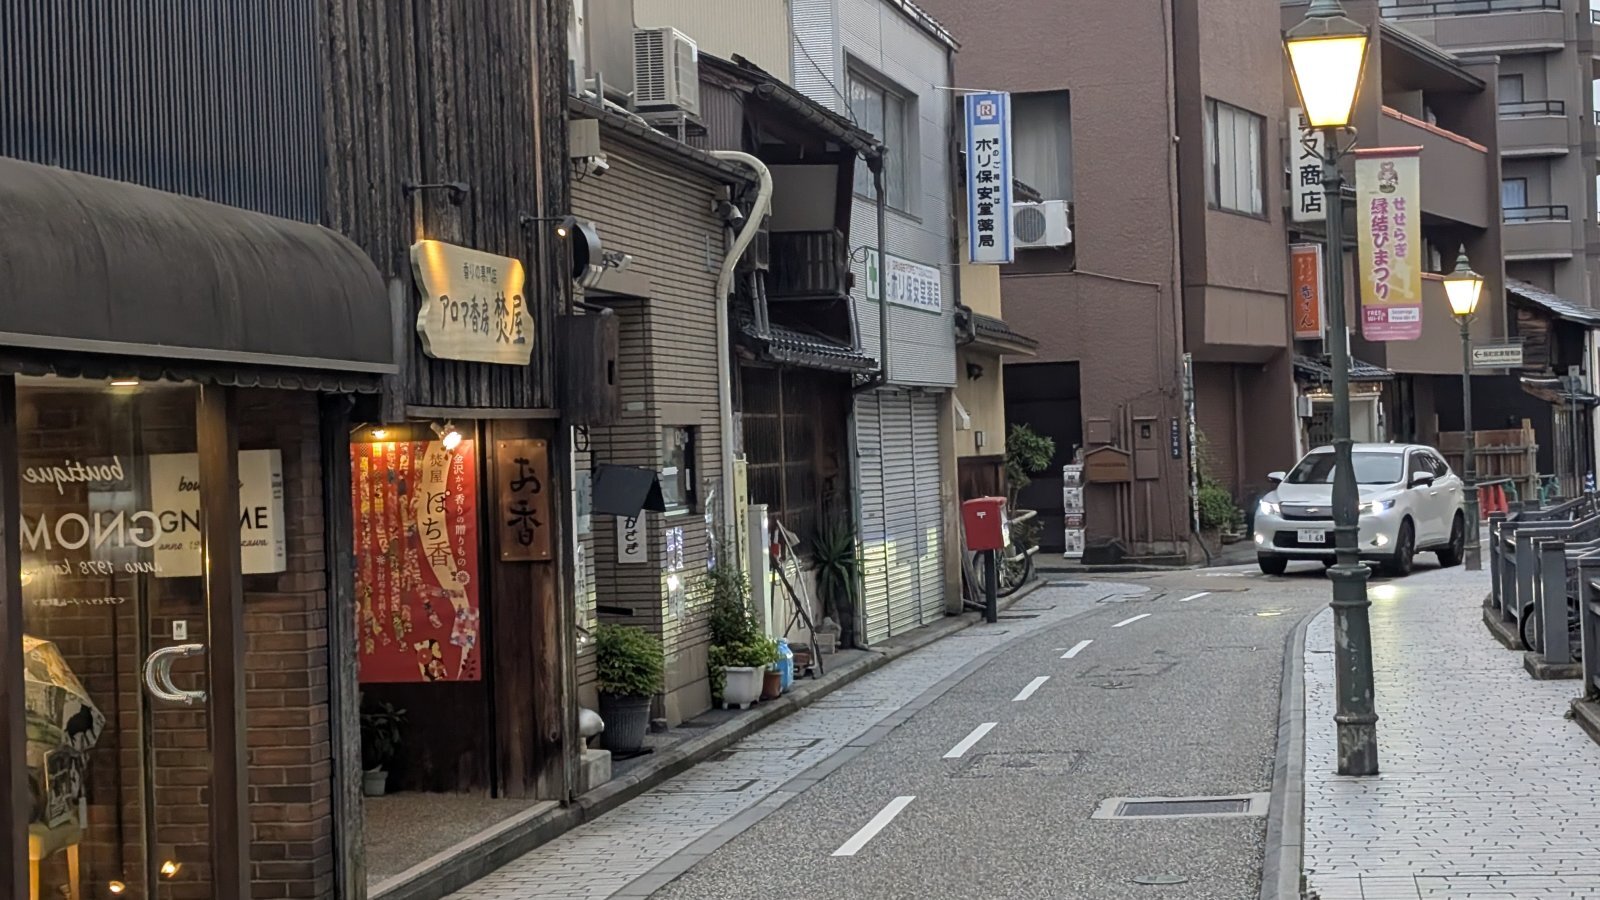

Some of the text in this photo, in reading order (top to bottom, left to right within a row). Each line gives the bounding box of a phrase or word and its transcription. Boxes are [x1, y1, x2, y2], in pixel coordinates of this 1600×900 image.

[975, 138, 995, 248] ホリ保安堂薬局
[1392, 196, 1408, 258] せせらぎ
[159, 506, 268, 533] GNME
[422, 489, 452, 567] ぽち香
[507, 457, 543, 548] お香
